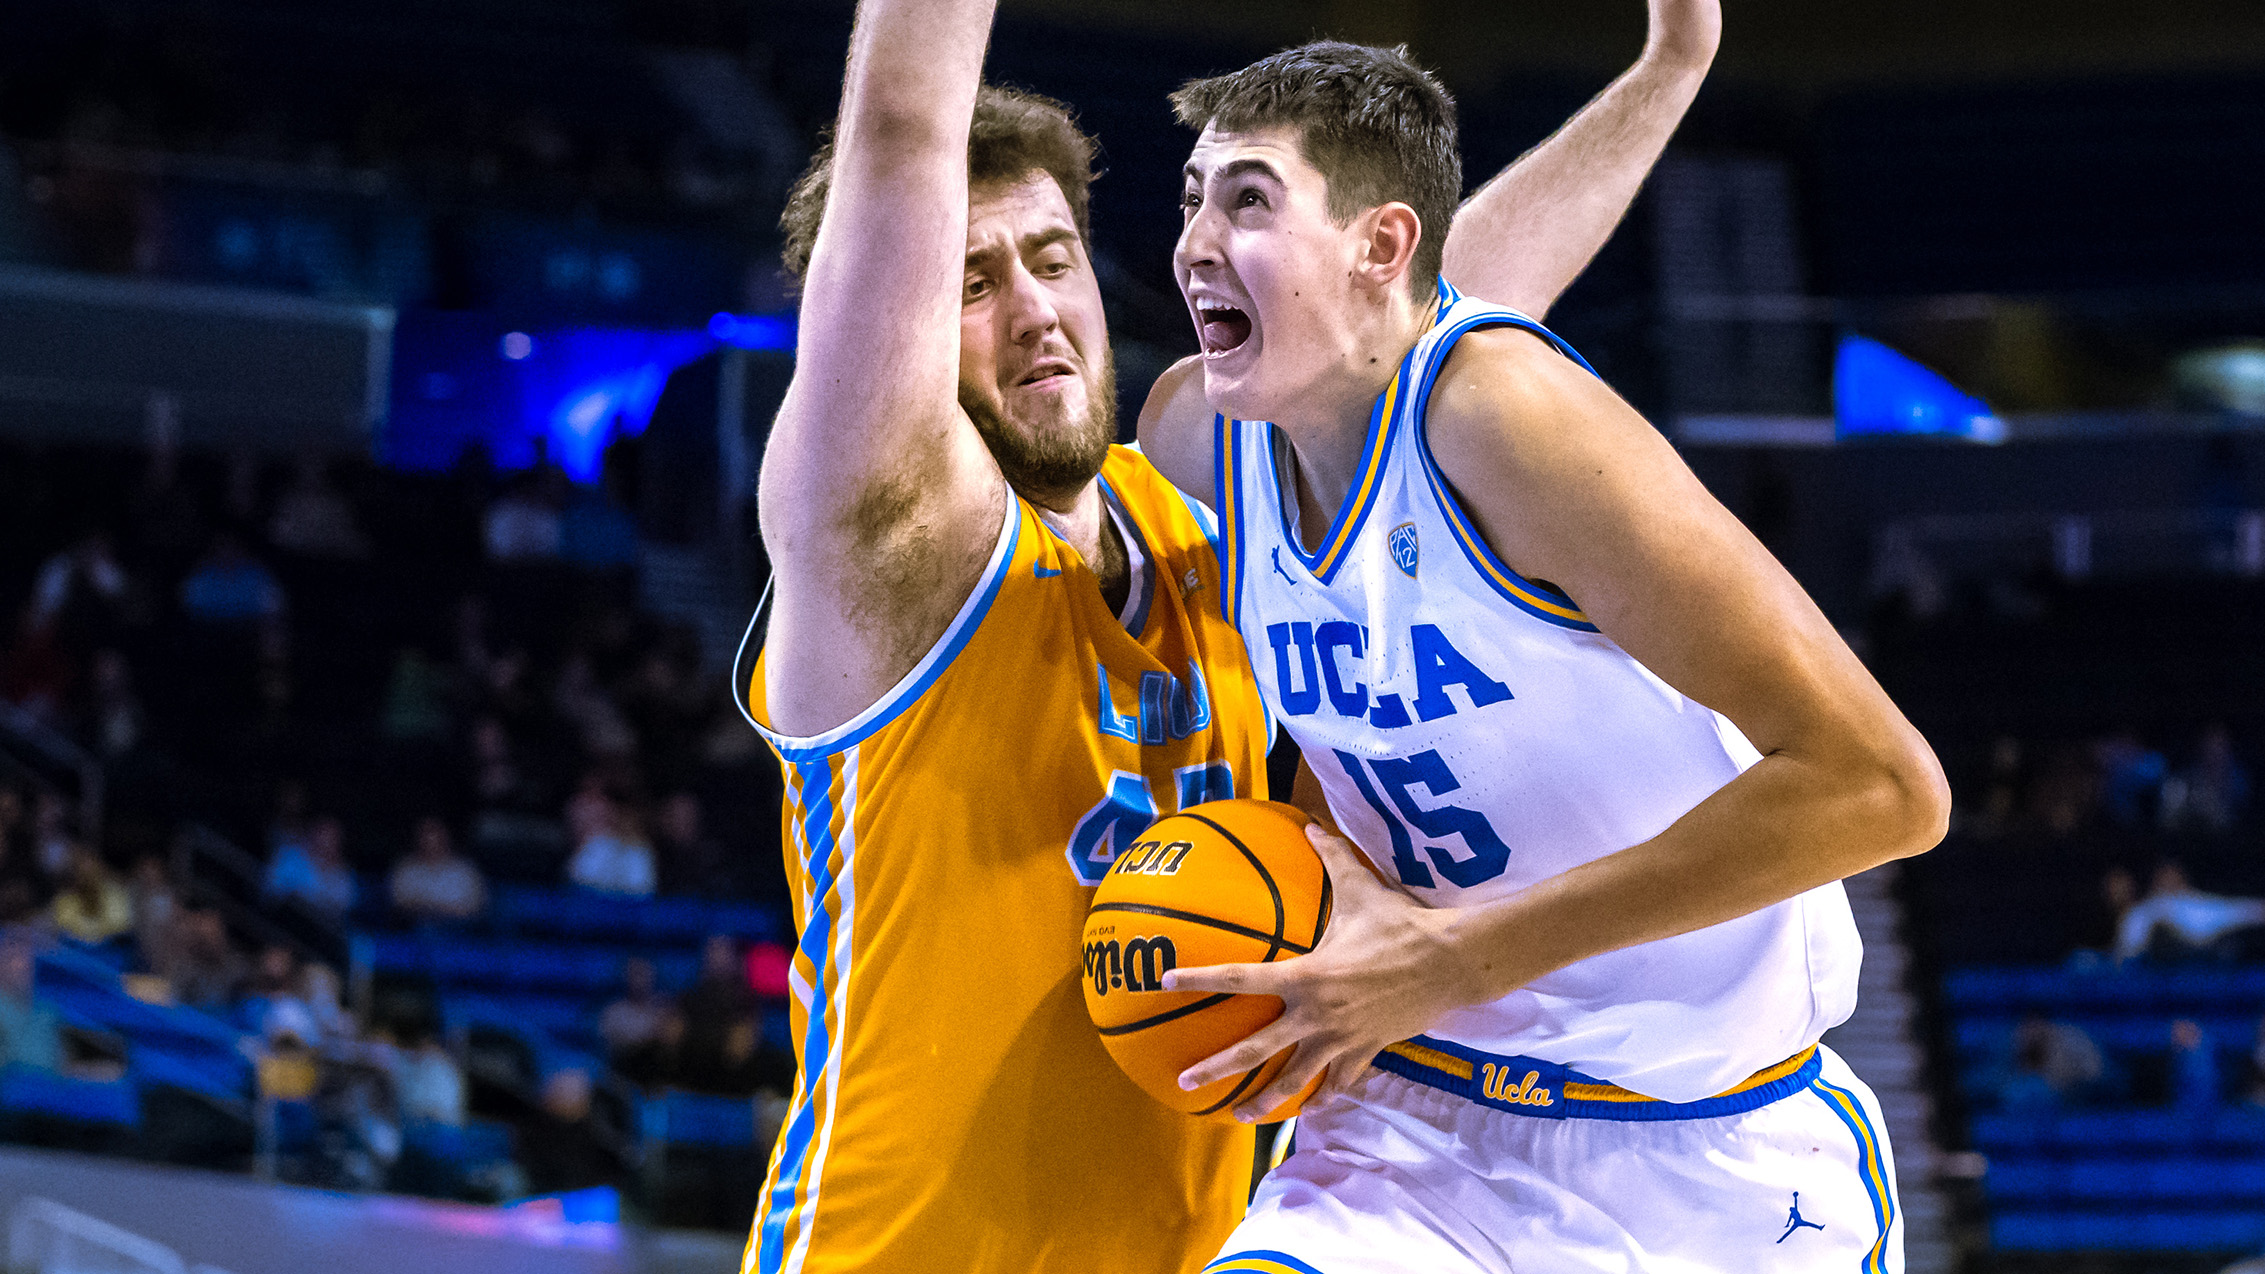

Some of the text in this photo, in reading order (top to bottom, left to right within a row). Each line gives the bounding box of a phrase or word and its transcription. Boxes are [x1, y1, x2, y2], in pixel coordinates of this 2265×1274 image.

[1390, 526, 1417, 560] PAC
[1399, 547, 1416, 569] 12
[1097, 656, 1211, 746] LIU
[1331, 748, 1512, 889] 15
[1114, 839, 1194, 876] UCL
[1082, 934, 1177, 996] Wils
[1482, 1063, 1554, 1107] Ucla
